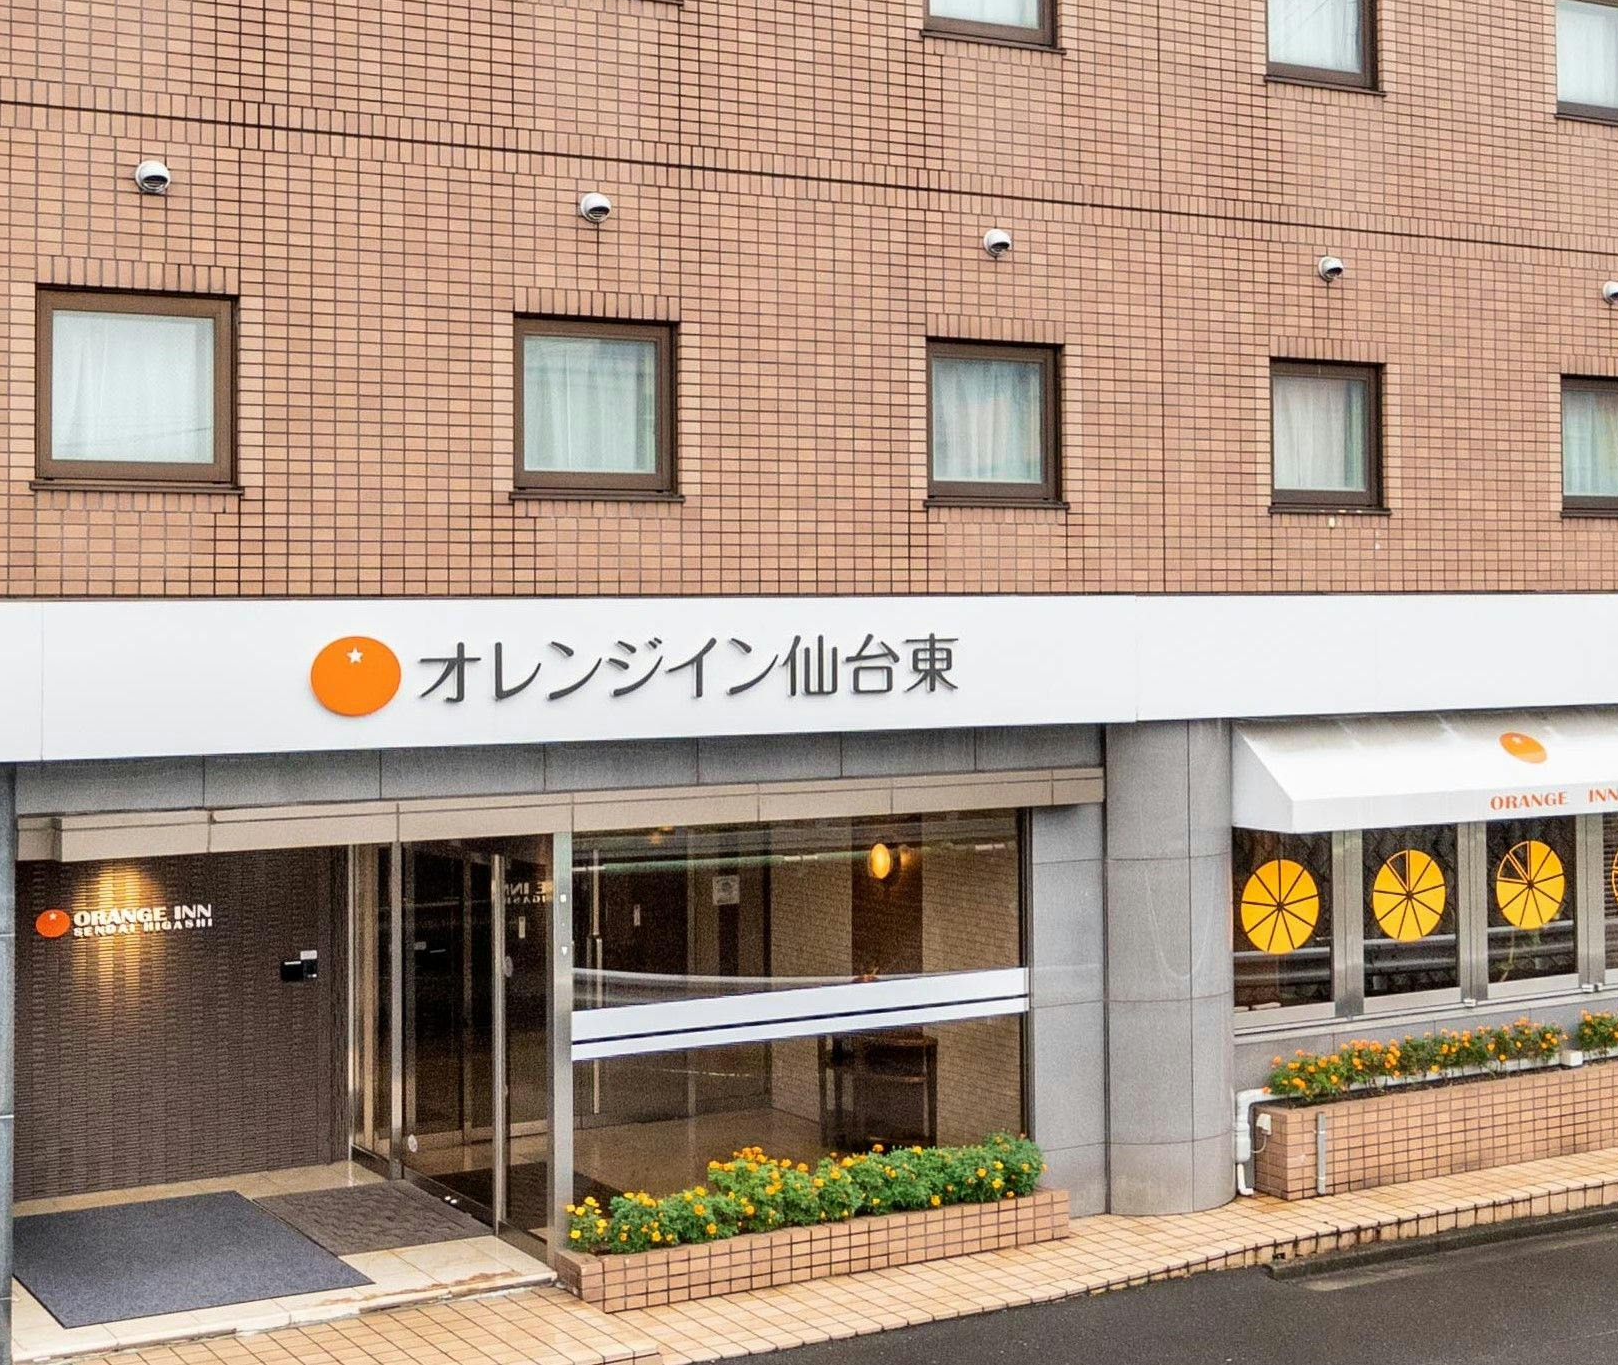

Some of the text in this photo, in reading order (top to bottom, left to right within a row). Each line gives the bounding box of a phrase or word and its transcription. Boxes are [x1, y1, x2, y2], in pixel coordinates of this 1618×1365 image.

[417, 632, 961, 705] オレンジイン仙台東
[1489, 789, 1568, 812] ORANGE
[73, 903, 213, 927] ORANGE INN
[73, 917, 214, 938] SENDAI HIGASHI
